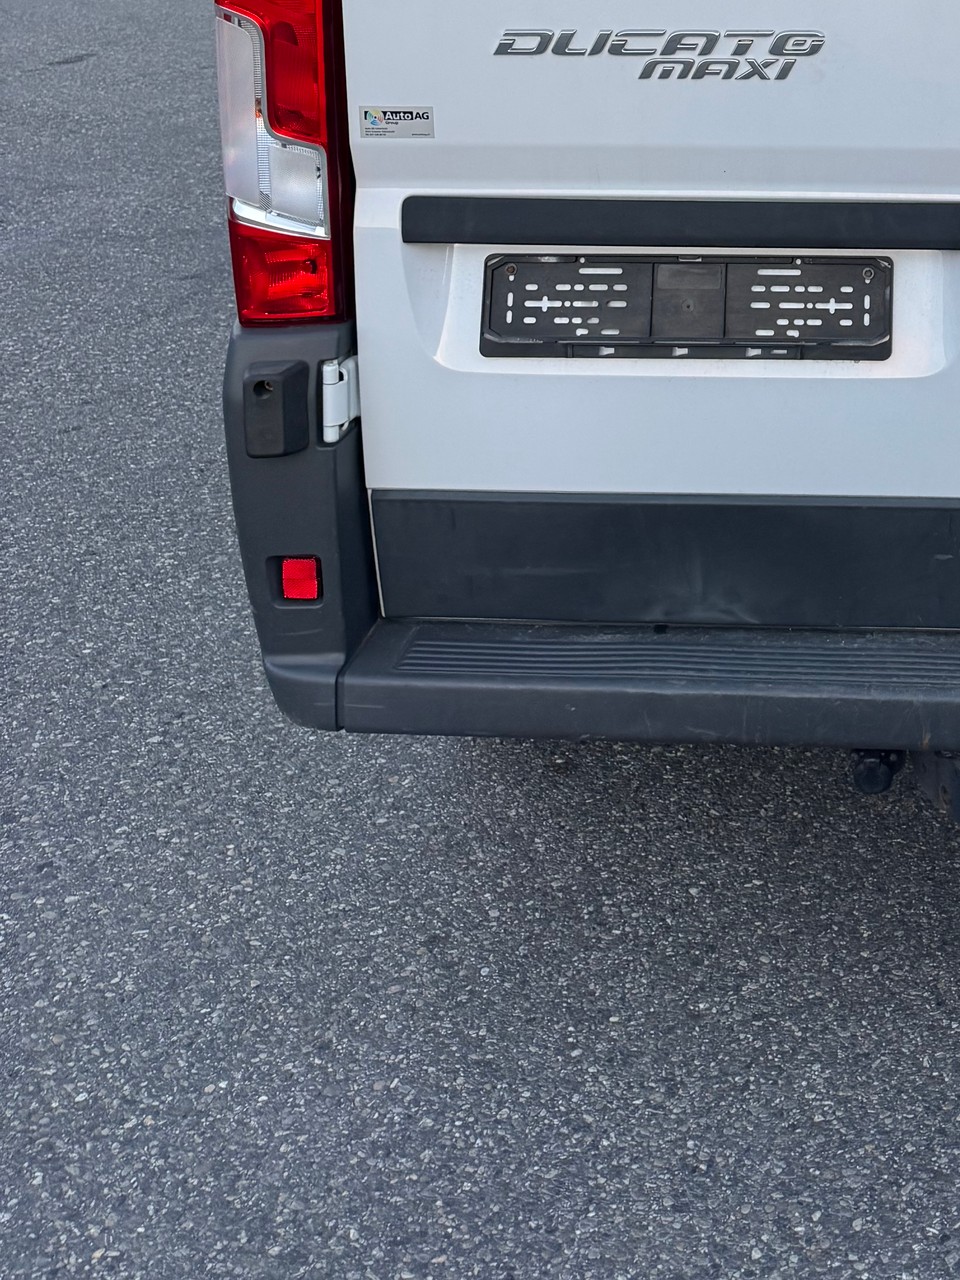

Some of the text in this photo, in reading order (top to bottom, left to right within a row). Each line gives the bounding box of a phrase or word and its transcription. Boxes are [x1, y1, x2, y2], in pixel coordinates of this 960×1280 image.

[493, 28, 826, 57] DUCATO
[637, 57, 797, 81] MAXI
[385, 111, 430, 120] Auto AG
